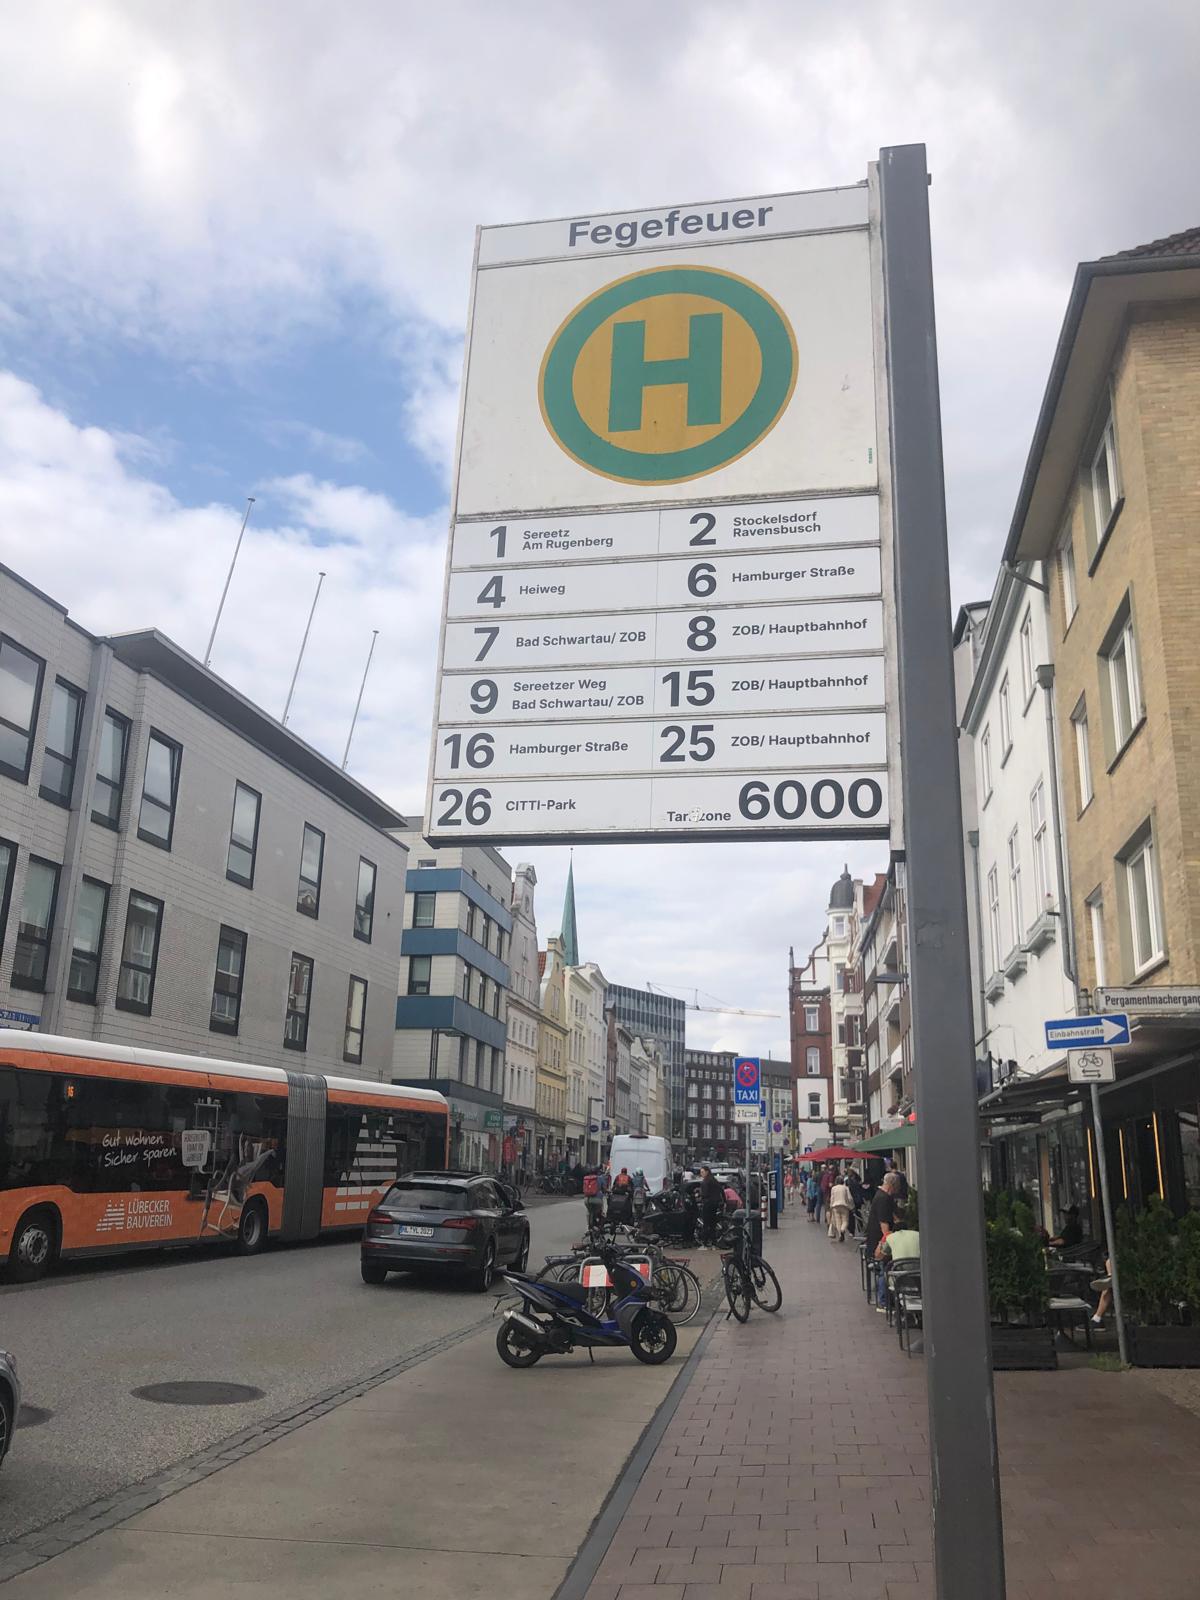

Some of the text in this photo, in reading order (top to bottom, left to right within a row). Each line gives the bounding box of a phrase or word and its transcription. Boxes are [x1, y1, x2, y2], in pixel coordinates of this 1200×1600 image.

[569, 206, 773, 248] Fegefeuer
[608, 312, 723, 432] H
[734, 512, 818, 527] Stockelsdorf
[524, 530, 569, 539] Sereetz
[690, 513, 716, 546] 2
[734, 521, 820, 537] Ravensbusch
[491, 526, 506, 557] 1
[523, 534, 612, 550] Am Rugenberg
[688, 563, 716, 597] 6
[733, 567, 854, 582] Hamburger Straße
[477, 576, 505, 608] 4
[520, 586, 565, 594] Heiweg
[687, 616, 716, 651] 8
[733, 619, 867, 635] ZOB/ Hauptbahnhof
[475, 627, 499, 661] 7
[517, 632, 645, 647] Bad Schwartau/ ZOB
[514, 680, 606, 691] Sereetzer Weg
[663, 670, 714, 706] 15
[732, 675, 868, 691] ZOB/ Hauptbahnhof
[470, 680, 498, 714] 9
[513, 696, 643, 709] Bad Schwartau/ ZOB
[660, 725, 715, 762] 25
[732, 732, 870, 747] ZOB/ Hauptbahnhof
[444, 733, 494, 769] 16
[510, 741, 628, 755] Hamburger Straße
[438, 788, 491, 826] 26
[506, 799, 575, 810] CITTI-Park
[739, 778, 882, 820] 6000
[1050, 1028, 1104, 1038] Einbahnstraße
[737, 1090, 758, 1100] TAXI
[102, 1129, 120, 1147] Gut
[104, 1149, 138, 1167] Sicher
[128, 1198, 169, 1214] LÜBECKER
[127, 1214, 173, 1229] BAUVEREIN
